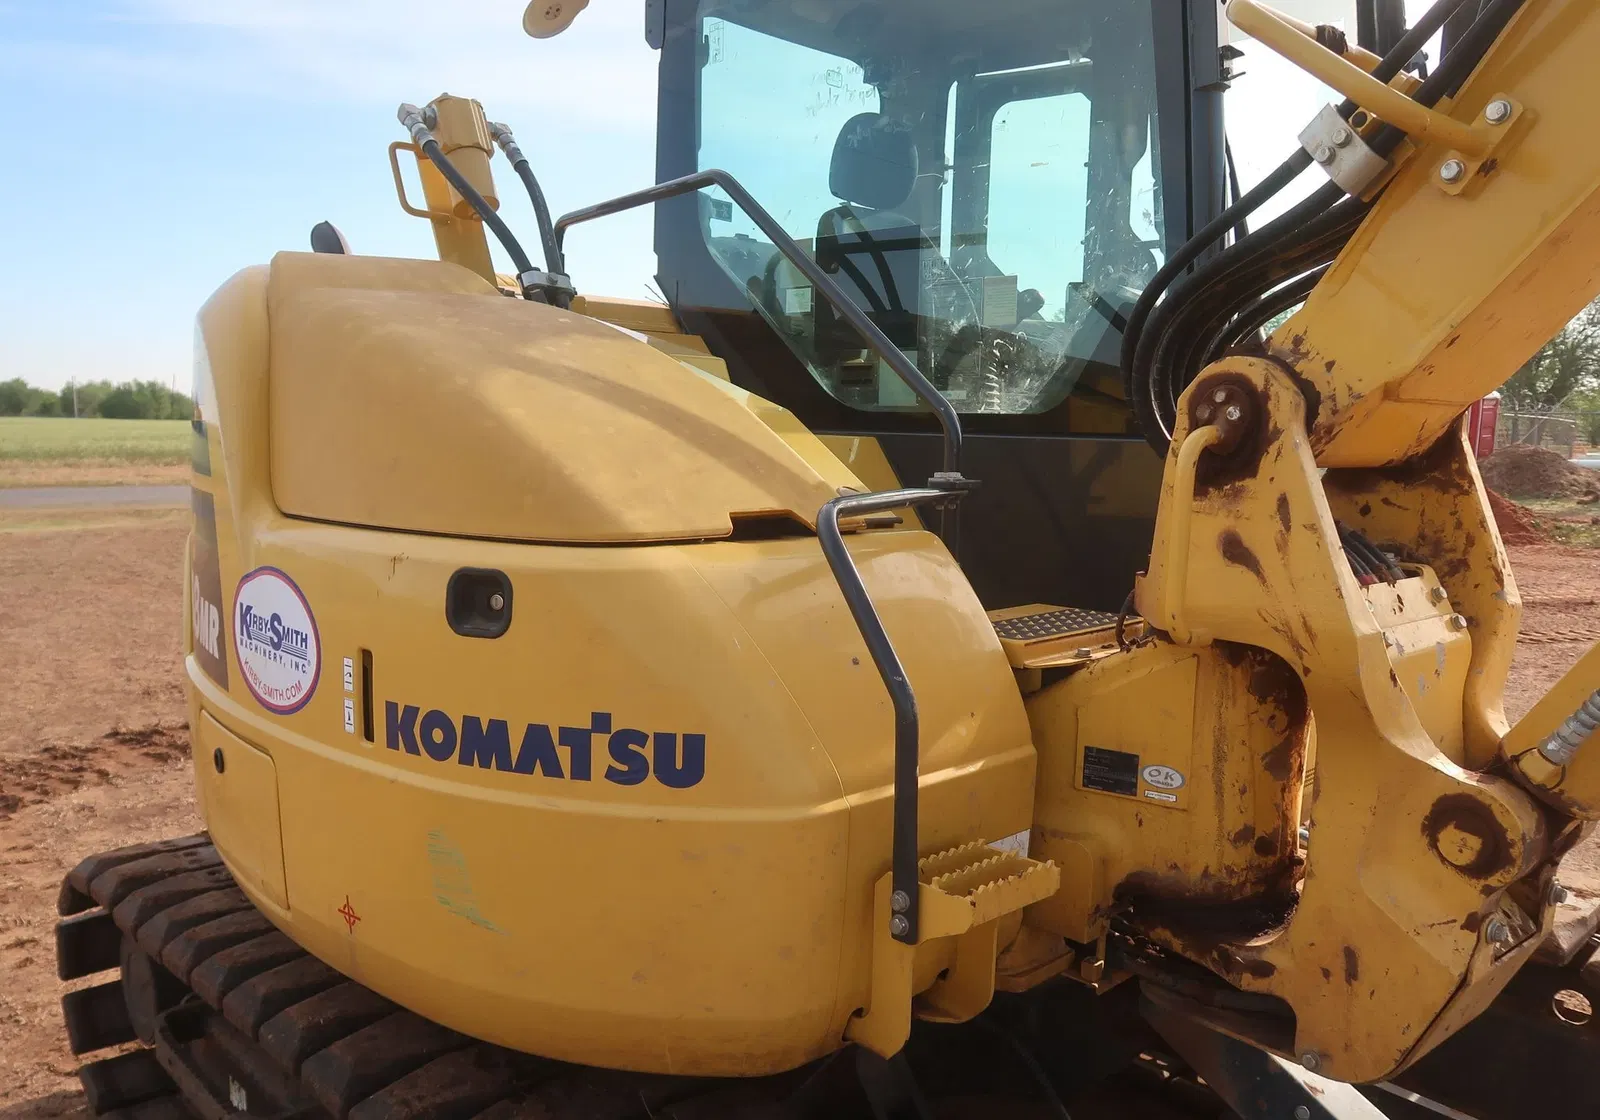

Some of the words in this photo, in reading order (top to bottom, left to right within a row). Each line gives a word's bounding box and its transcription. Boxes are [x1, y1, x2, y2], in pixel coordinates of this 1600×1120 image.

[239, 601, 308, 651] KIRBY-SMITH
[240, 637, 287, 668] MACHINERY,
[243, 657, 303, 701] KIRBY-SMITH.COM
[385, 700, 706, 789] KOMATSU
